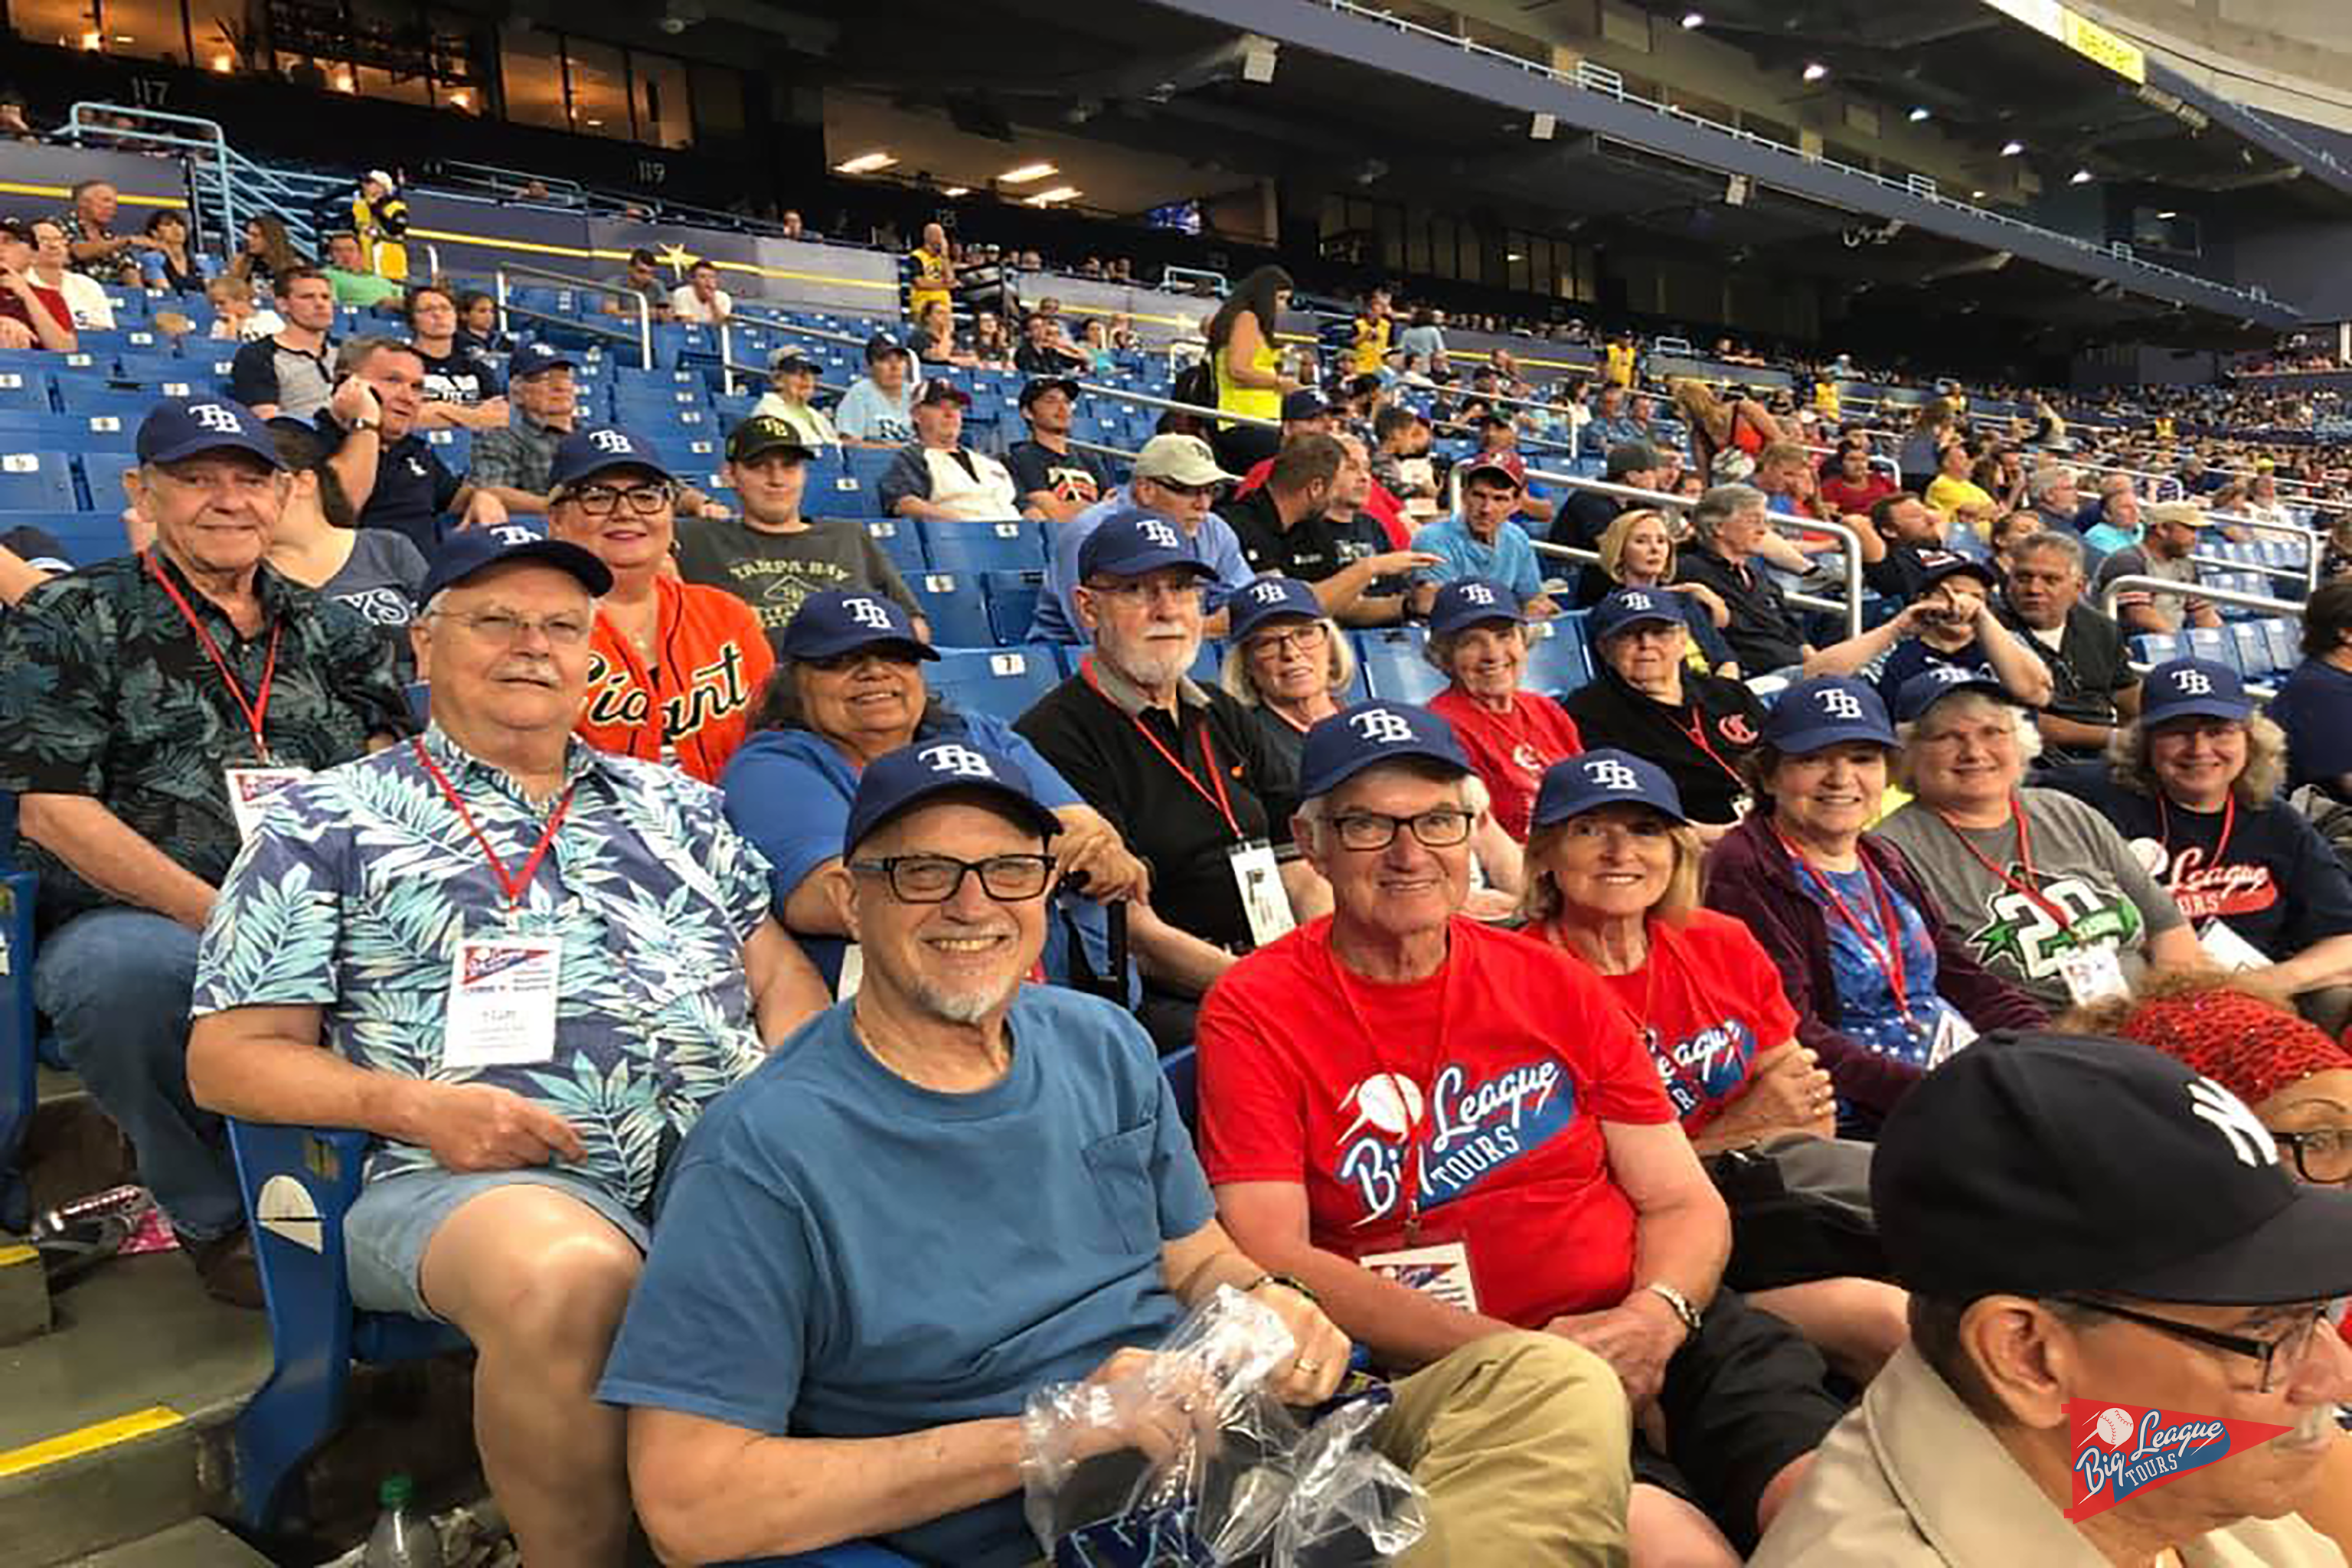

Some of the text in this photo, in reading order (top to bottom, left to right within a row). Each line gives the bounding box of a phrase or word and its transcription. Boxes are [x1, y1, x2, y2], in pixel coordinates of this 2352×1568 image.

[131, 77, 169, 105] 117
[639, 159, 665, 184] 119
[189, 404, 241, 432] TB
[589, 430, 632, 453] TB
[1135, 520, 1178, 547] TB
[1250, 581, 1289, 604] TB
[1459, 583, 1494, 605] TB
[1620, 592, 1652, 610] TB
[842, 598, 891, 628] TB
[2171, 670, 2212, 694] TB
[1815, 688, 1862, 718] TB
[1349, 709, 1412, 743] TB
[918, 744, 993, 776] TB
[1583, 760, 1637, 789] TB
[1432, 1063, 1559, 1152] League
[1430, 1125, 1519, 1187] TOURS
